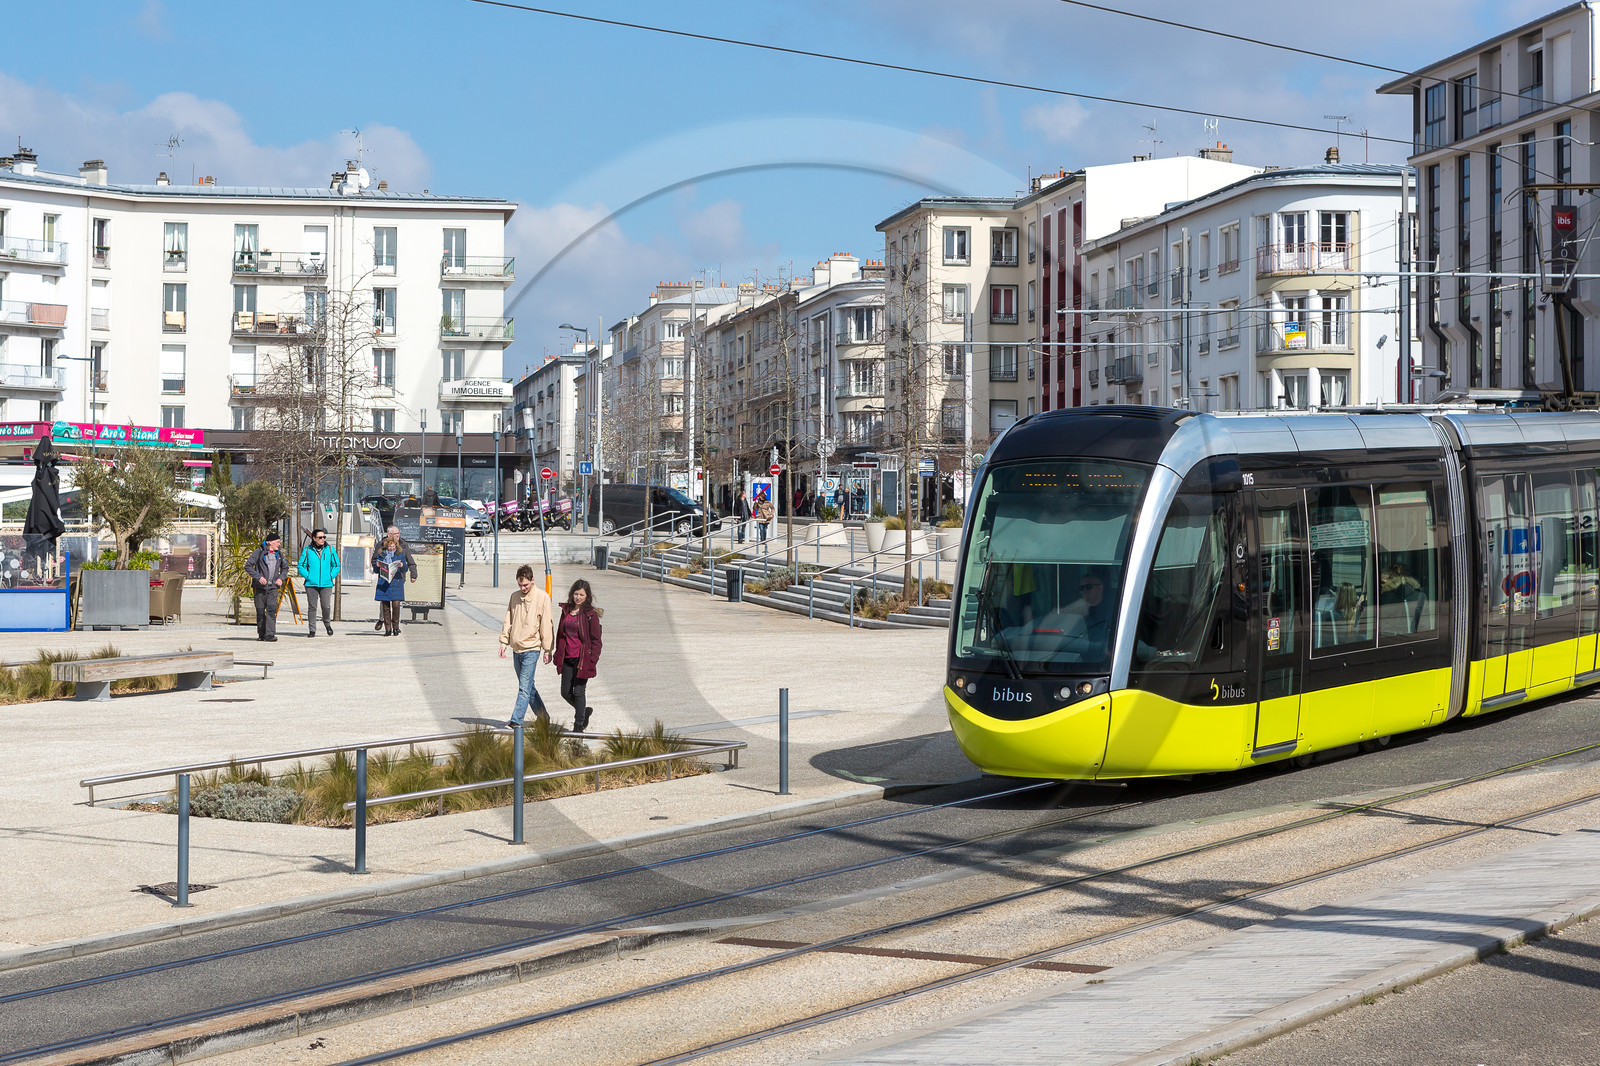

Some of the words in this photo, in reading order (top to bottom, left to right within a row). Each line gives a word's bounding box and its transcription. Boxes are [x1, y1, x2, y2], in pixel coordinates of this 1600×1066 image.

[1557, 216, 1571, 225] ibis
[451, 387, 504, 395] IMMOBILIERE
[13, 424, 34, 436] Stand
[100, 426, 126, 439] Are'o
[131, 427, 159, 440] Stand
[1242, 472, 1254, 485] 1015
[992, 686, 1032, 702] bibus
[1221, 684, 1245, 699] bibus
